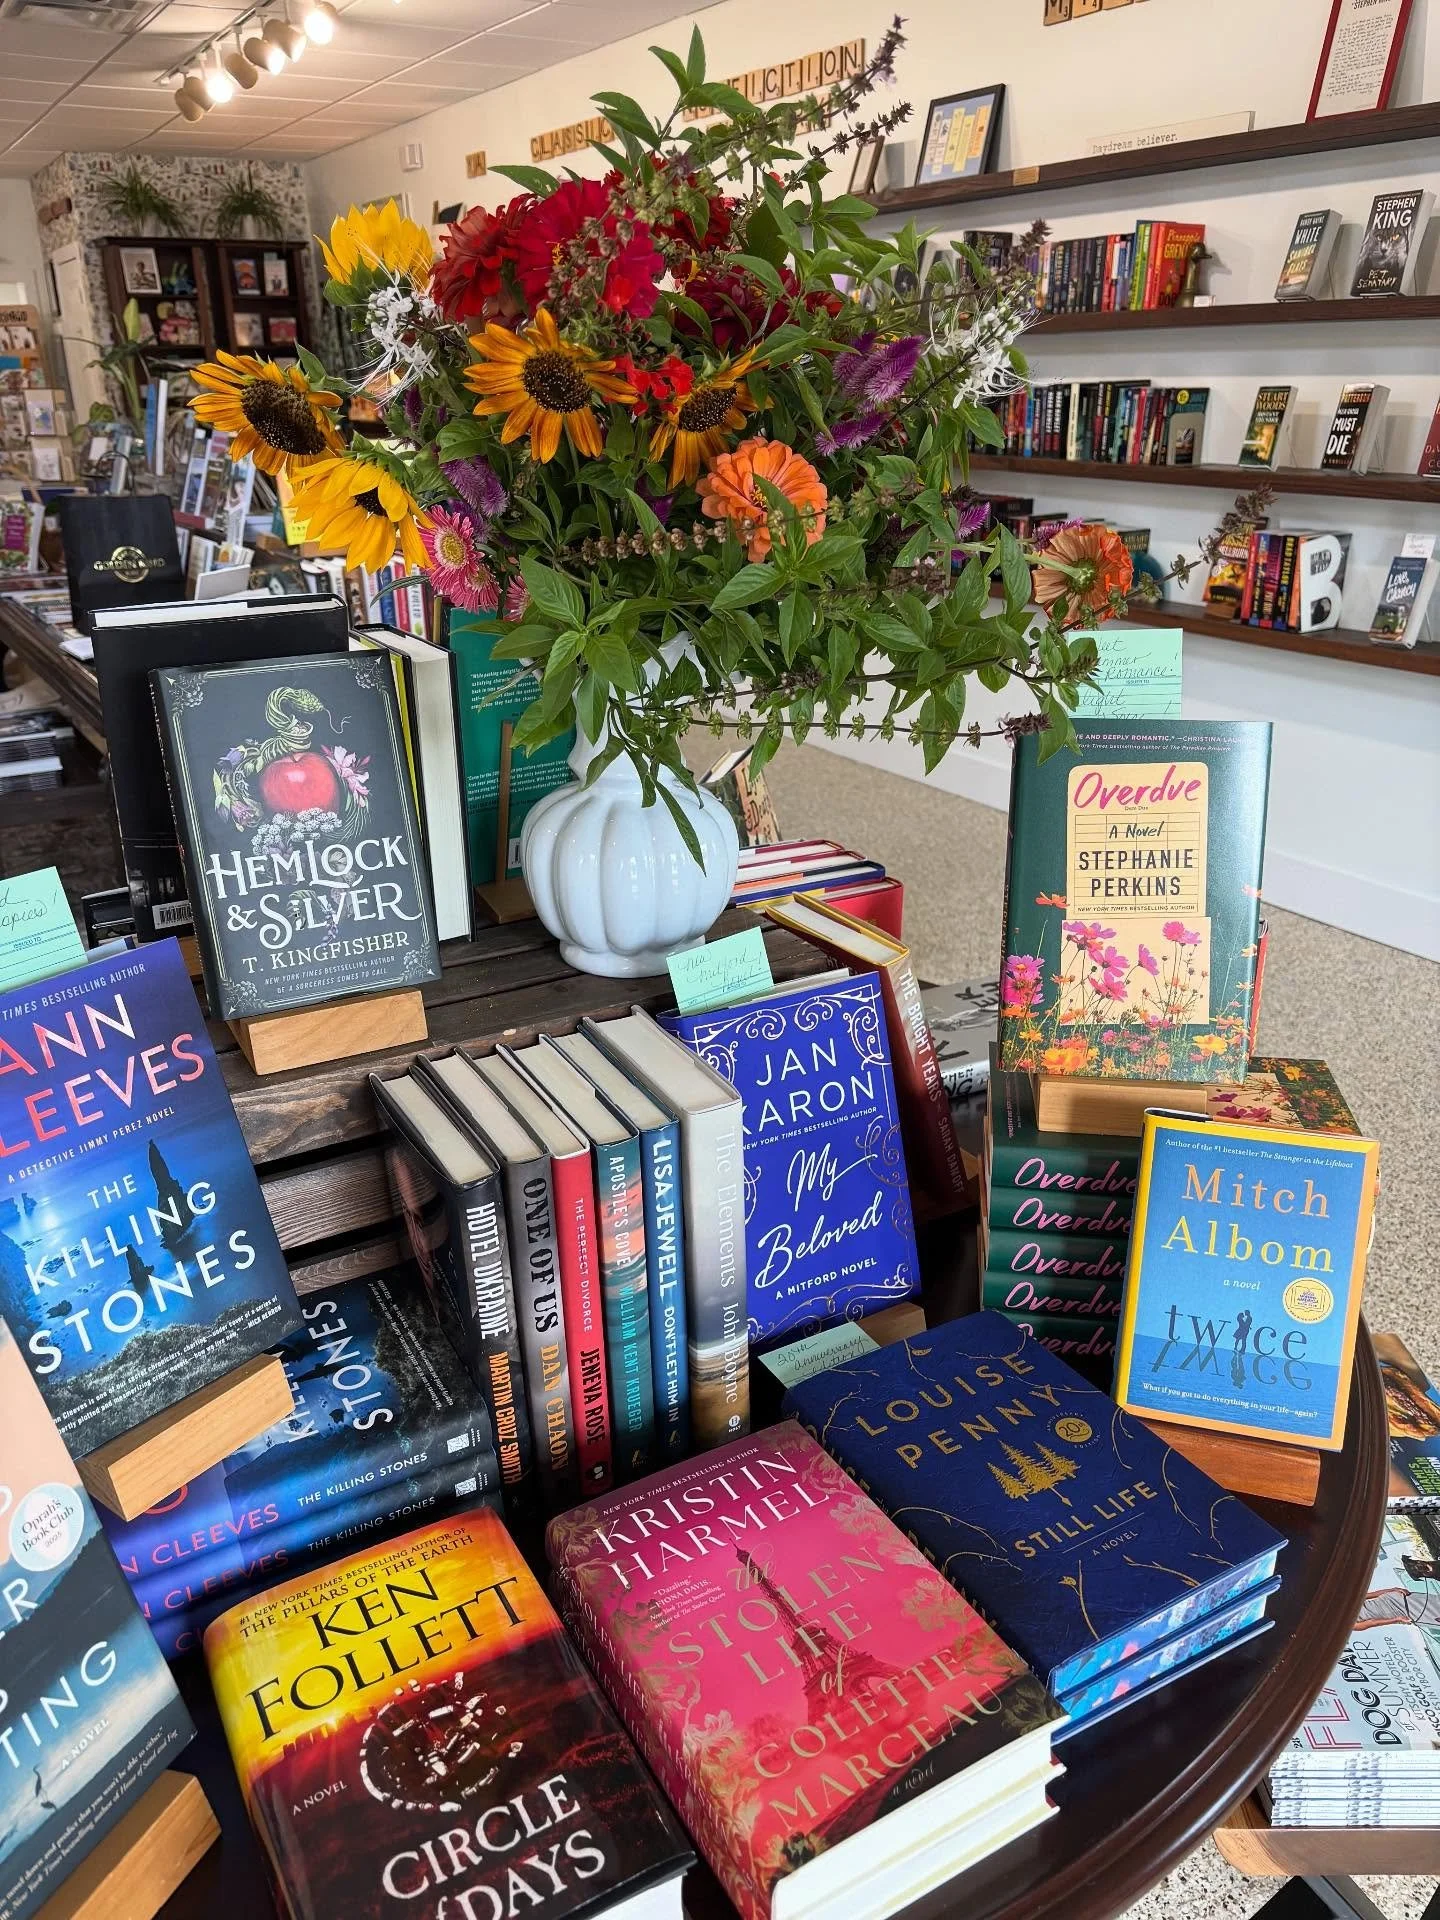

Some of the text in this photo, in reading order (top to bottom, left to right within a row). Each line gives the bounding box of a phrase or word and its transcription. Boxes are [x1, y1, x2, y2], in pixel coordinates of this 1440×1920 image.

[1136, 133, 1178, 147] believer.
[1372, 209, 1412, 229] KING
[1376, 197, 1417, 212] STEPHEN
[1295, 226, 1322, 244] WHITE
[1256, 401, 1286, 411] WOODS
[1258, 391, 1289, 401] STUART
[1326, 434, 1351, 455] DIE
[1333, 418, 1358, 431] MUST
[1074, 765, 1201, 810] Overdue
[1109, 821, 1164, 839] A Novel
[206, 835, 408, 899] HEMLOCK
[1079, 849, 1193, 870] STEPHANIE
[1091, 876, 1181, 897] PERKINS
[227, 905, 256, 932] &
[242, 931, 409, 974] T. KINGFISHER
[282, 955, 395, 982] YORK TIMES BESTSELLING AUTHOR
[2, 963, 146, 1021] TIMES BESTSELLING AUTHOR
[295, 972, 359, 990] SORCERESS COMES
[756, 1039, 837, 1086] JAN
[899, 968, 915, 1003] THE
[908, 1002, 932, 1059] BRIGHT
[923, 1057, 941, 1102] YEARS
[19, 1106, 175, 1179] DETECTIVE JIMMY PEREZ NOVEL
[760, 1107, 877, 1145] YORK TIMES BESTSELLING AUTHOR
[1165, 1139, 1302, 1164] Author bestseller Stranger
[88, 1174, 137, 1209] THE
[787, 1143, 878, 1211] My
[1014, 1158, 1136, 1192] Overdue
[1182, 1163, 1330, 1218] Mitch
[25, 1182, 216, 1296] KILLING
[652, 1139, 676, 1300] LISA JEWELL
[755, 1191, 883, 1288] Beloved
[1162, 1216, 1335, 1273] Albom
[715, 1127, 740, 1403] The Elements John Boyne
[787, 1256, 878, 1297] MITFORD NOVEL
[1235, 1279, 1261, 1292] novel
[29, 1230, 256, 1375] STONES
[574, 1198, 606, 1445] THE PERFECT DIVORCE JENEVA ROSE
[609, 1155, 643, 1432] APOSTLE'S COVE WILLIAM KENT KRUEGER
[466, 1202, 519, 1444] HOTEL UKRAINE MARTIN CRUZ
[523, 1177, 570, 1471] ONE OF US DAN CHAON
[1164, 1304, 1308, 1360] twice
[302, 1301, 393, 1431] STONES
[855, 1352, 1036, 1438] LOUISE
[1143, 1382, 1249, 1409] What everything
[896, 1383, 1063, 1469] PENNY
[298, 1453, 428, 1507] THE KILLING STONES
[592, 1450, 798, 1554] KRISTIN
[603, 1447, 759, 1516] NEW YORK TIMES BESTSELLING AUTHOR
[22, 1498, 61, 1534] Oprah's
[22, 1506, 74, 1552] Book Club
[152, 1503, 280, 1567] CLEEVES
[308, 1496, 436, 1551] THE KILLING STONES
[609, 1481, 831, 1590] HARMEL
[1014, 1479, 1160, 1559] STILL LIFE
[1101, 1529, 1138, 1552] NOVEL
[163, 1549, 290, 1611] CLEEVES
[240, 1535, 474, 1638] THE PILLARS OF THE EARTH
[254, 1527, 466, 1618] NEW YORK TIMES BESTSELLING AUTHOR OF
[307, 1568, 439, 1651] KEN
[667, 1546, 887, 1669] STOLEN
[245, 1578, 526, 1743] FOLLETT
[741, 1603, 874, 1687] LIFE
[1384, 1636, 1430, 1708] GOLF ROOSTER
[820, 1659, 851, 1701] of
[1353, 1642, 1411, 1718] SUMMER
[1400, 1686, 1426, 1720] KITSCHY
[71, 1718, 109, 1758] NOVEL
[752, 1649, 969, 1782] COLETTE
[1351, 1688, 1403, 1744] DOG
[767, 1681, 1003, 1833] MARCEAU
[304, 1780, 348, 1808] NOVEL
[382, 1774, 581, 1900] CIRCLE
[455, 1829, 606, 1920] DAYS
